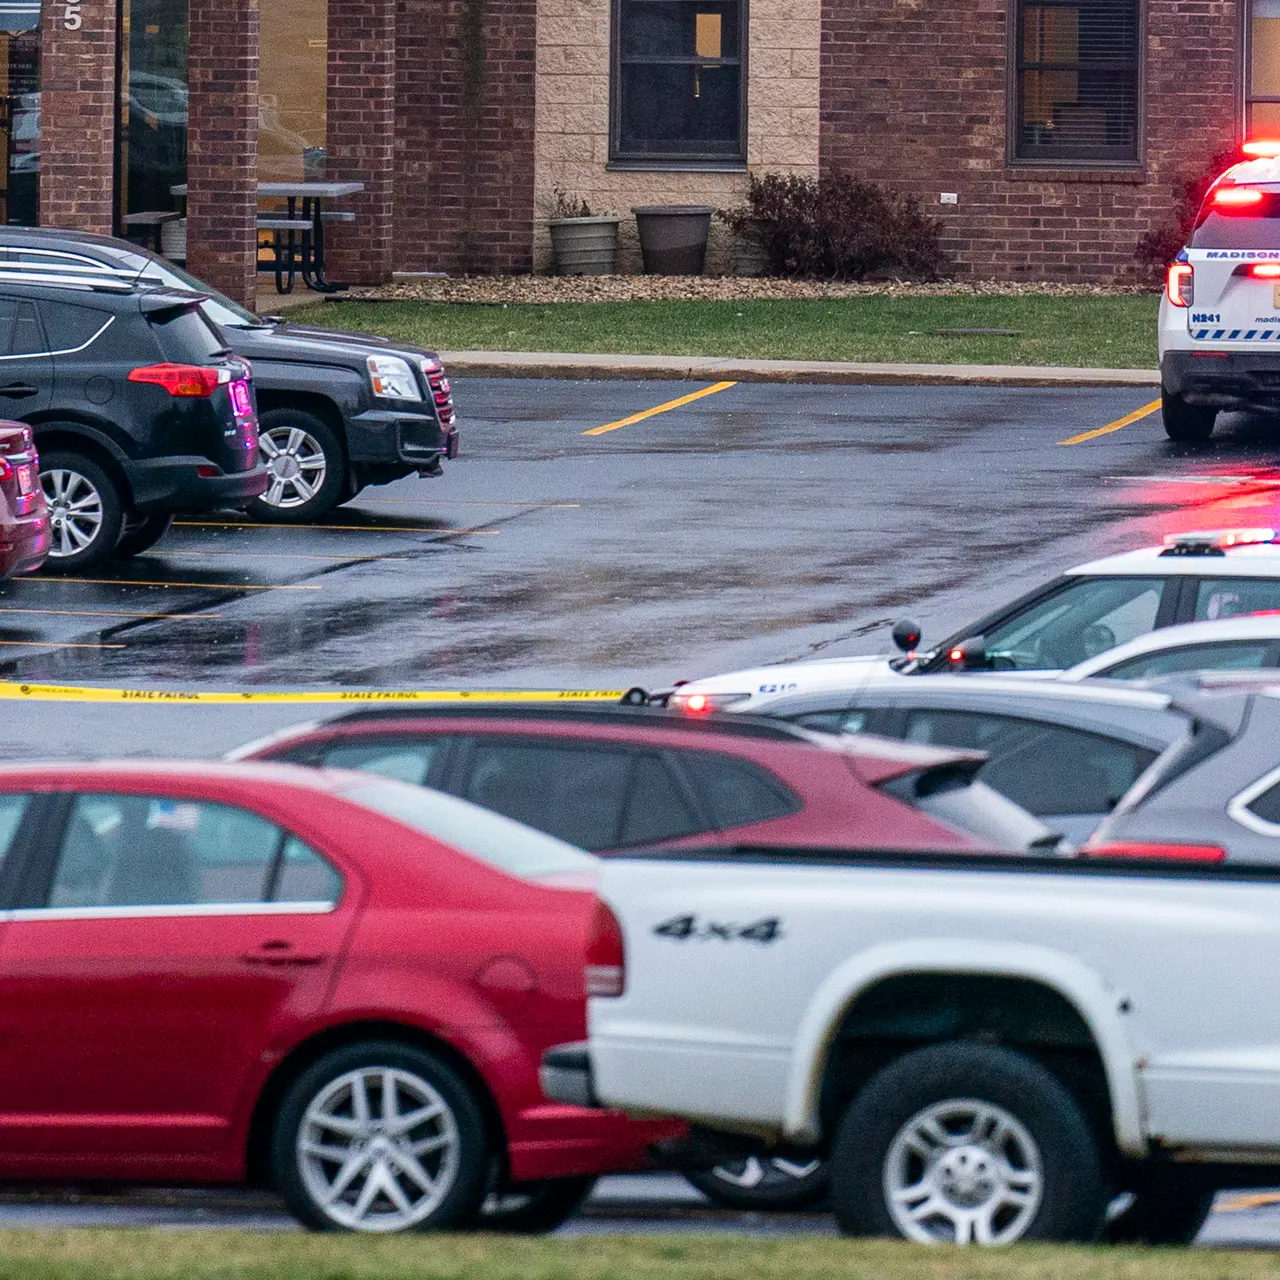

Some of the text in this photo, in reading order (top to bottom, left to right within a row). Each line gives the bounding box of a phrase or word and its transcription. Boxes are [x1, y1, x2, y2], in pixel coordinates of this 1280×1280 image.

[1206, 251, 1280, 260] MADISON
[1192, 313, 1221, 323] N241
[653, 913, 780, 941] 4x4
